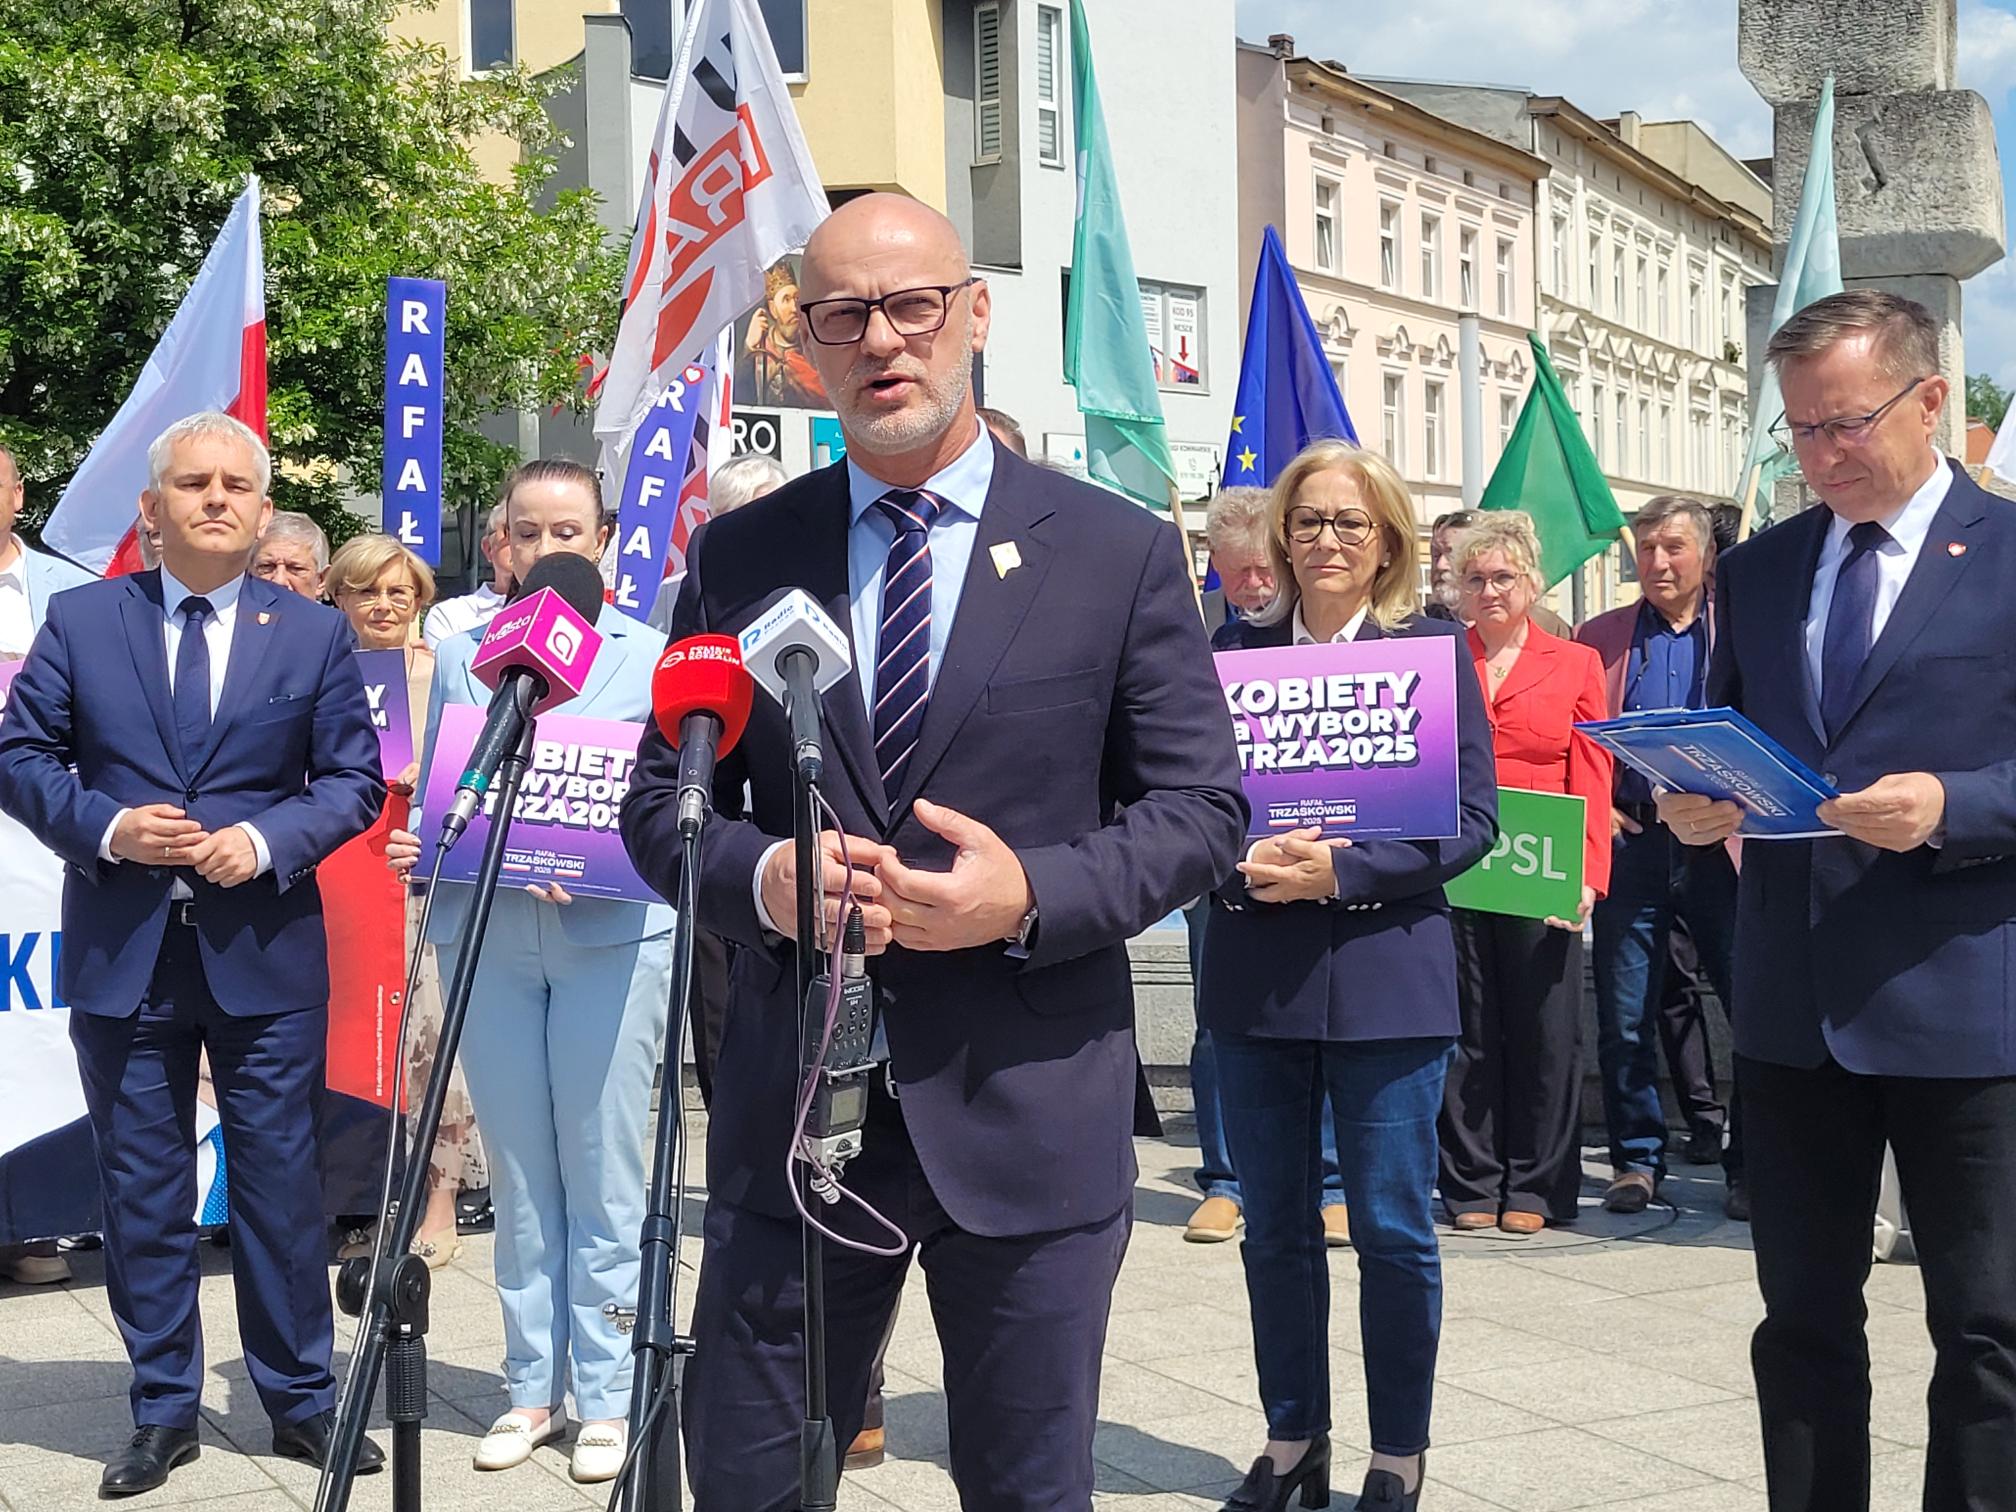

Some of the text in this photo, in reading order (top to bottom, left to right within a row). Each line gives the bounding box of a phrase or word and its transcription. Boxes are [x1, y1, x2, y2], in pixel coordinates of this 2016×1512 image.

[396, 299, 432, 546] RAFAŁ
[615, 379, 686, 609] RAFAŁ
[764, 604, 794, 630] Radio
[1234, 707, 1418, 741] a WYBORY
[508, 740, 638, 778] BIET
[519, 770, 632, 803] WYBOR
[1683, 744, 1788, 817] TRZASKOWSKI
[1269, 805, 1356, 818] TRZASKOWSKI
[1303, 817, 1322, 825] 2025
[504, 853, 585, 870] TRZASKOWSKI
[534, 849, 557, 858] RAFAŁ
[534, 866, 552, 874] 2025
[1482, 831, 1567, 881] PSL
